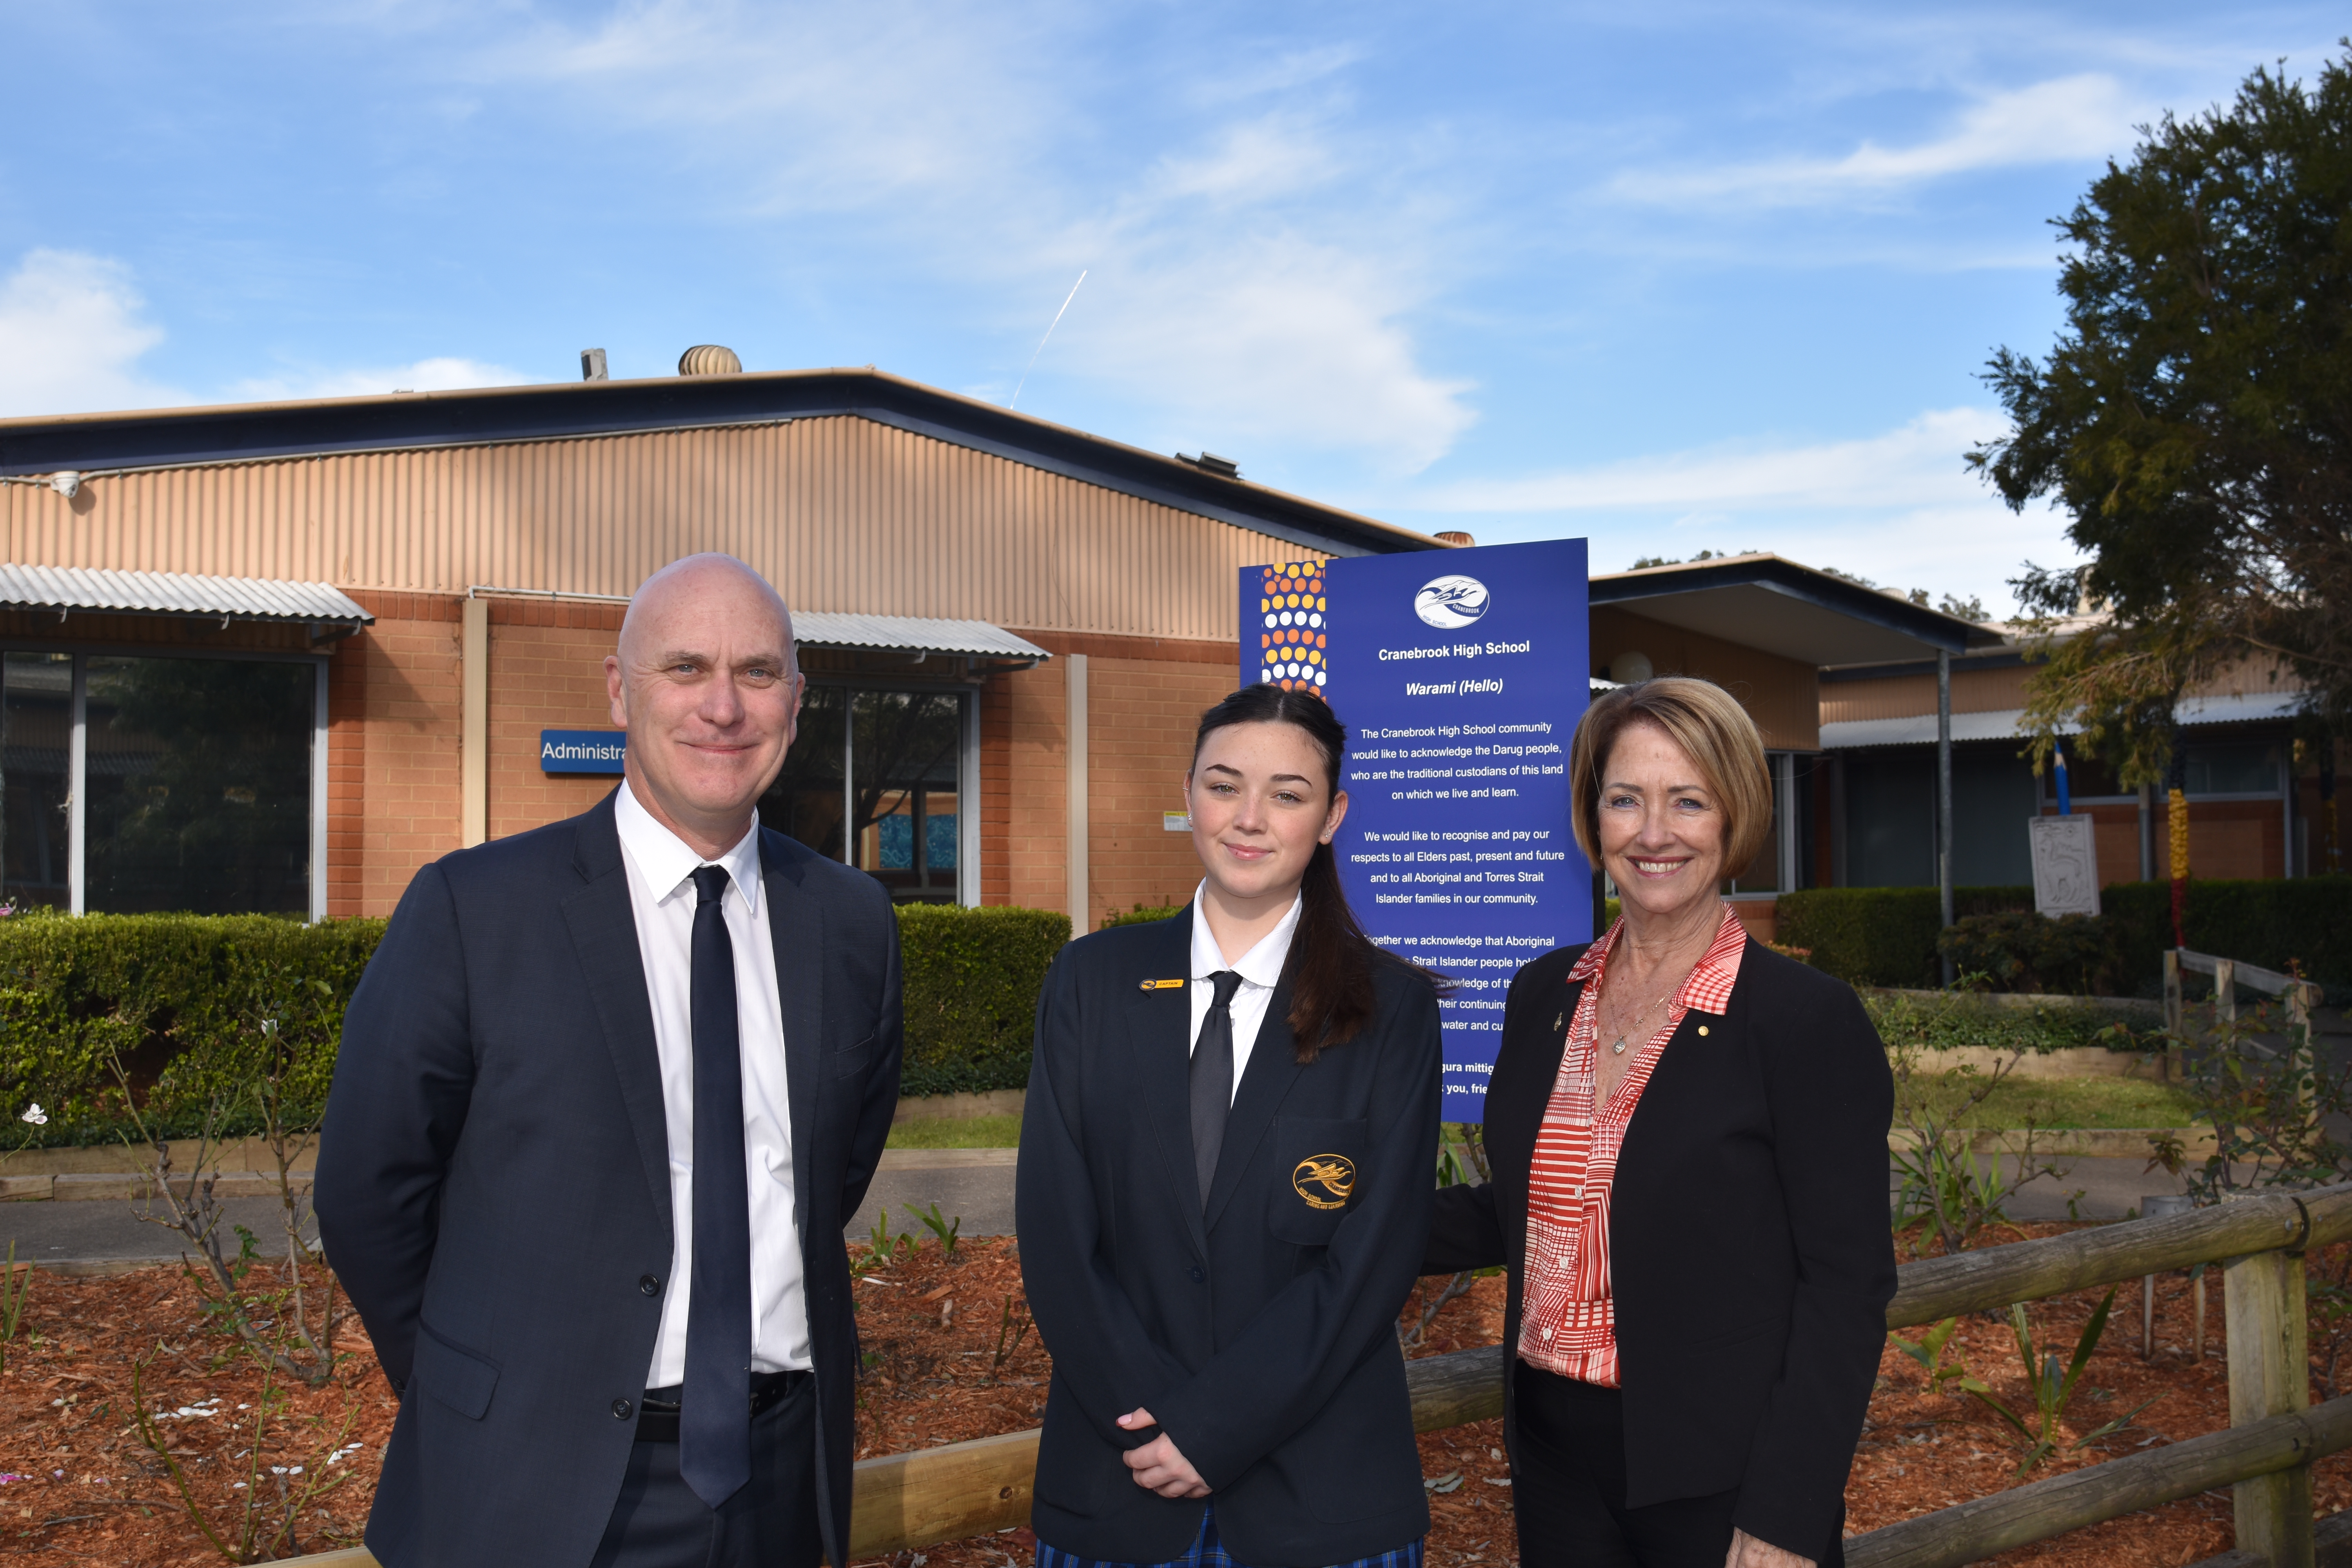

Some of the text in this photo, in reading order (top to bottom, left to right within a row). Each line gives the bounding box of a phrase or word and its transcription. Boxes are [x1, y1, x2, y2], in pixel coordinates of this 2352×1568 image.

[1452, 604, 1479, 613] CRANEBROOK
[1379, 640, 1530, 661] Cranebrook High School
[1406, 678, 1503, 696] Warami (Hello)
[1361, 722, 1552, 739] The Cranebrook High School community
[1352, 742, 1562, 760] would like to acknowledge the Darug people,
[1351, 764, 1563, 780] who are the traditional custodians of this land
[1406, 789, 1433, 799] which
[1452, 788, 1468, 798] live
[1471, 787, 1489, 798] and
[1492, 787, 1519, 797] learn.
[1364, 829, 1550, 842] We would like to recognise and pay our
[1351, 850, 1564, 864] respects to all Elders past, present and future
[1370, 871, 1544, 885] and to all Aboriginal and Torres Strait
[1376, 893, 1413, 903] Islander
[1415, 893, 1451, 903] families
[1454, 893, 1462, 903] in
[1483, 893, 1538, 906] community.
[1364, 935, 1402, 947] ogether
[1420, 935, 1483, 948] acknowledge
[1485, 936, 1504, 946] that
[1505, 936, 1554, 949] Aboriginal
[1412, 956, 1437, 966] Strait
[1440, 956, 1478, 967] Islander
[1480, 957, 1513, 969] people
[1491, 978, 1501, 988] of
[1503, 978, 1512, 988] th
[1441, 1020, 1468, 1030] water
[1470, 1020, 1489, 1031] and
[1465, 1062, 1494, 1075] mittig
[1446, 1085, 1468, 1095] you,
[1471, 1083, 1488, 1094] frie
[1299, 1187, 1321, 1202] HIGH SCHOOL
[1328, 1201, 1345, 1209] LEARNING
